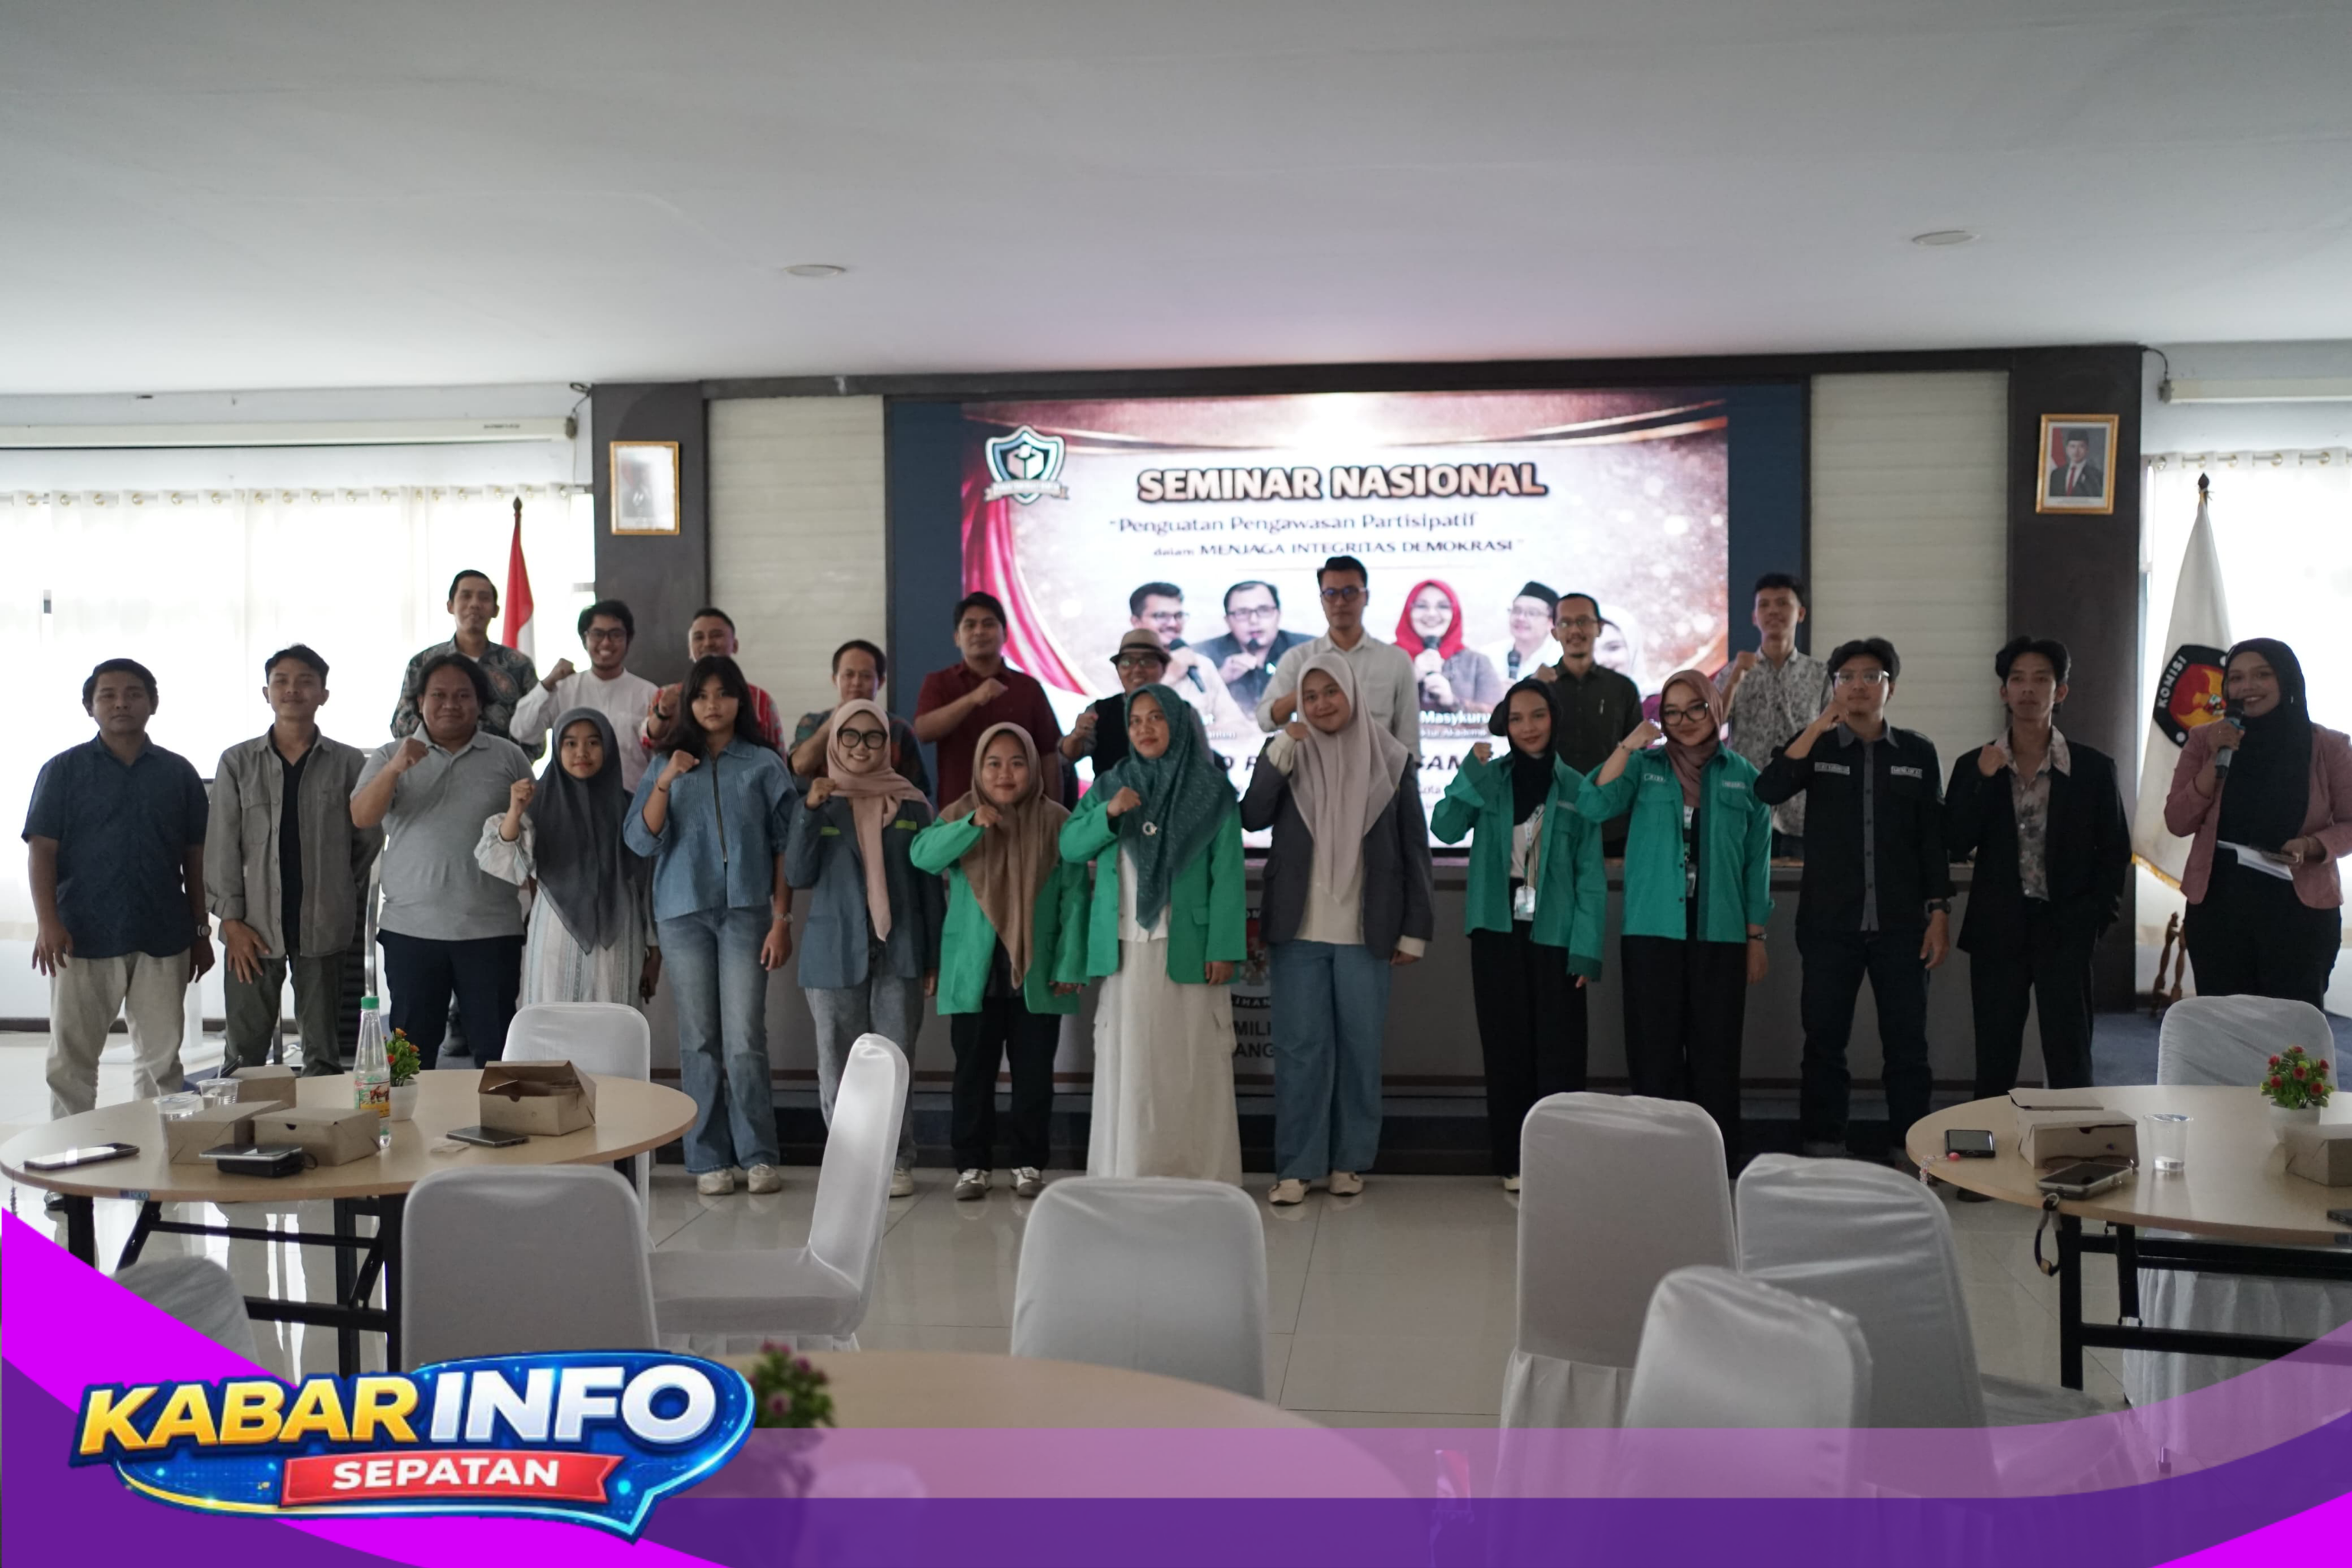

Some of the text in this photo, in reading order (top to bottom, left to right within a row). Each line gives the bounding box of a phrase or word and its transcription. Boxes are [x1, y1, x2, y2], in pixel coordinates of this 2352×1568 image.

[1138, 462, 1548, 502] SEMINAR NASIONAL
[1230, 514, 1356, 534] Pengawasan
[1362, 512, 1477, 531] Partisipatif
[1200, 543, 1285, 556] MENJAGA
[1292, 541, 1396, 554] INTEGRITAS
[2158, 655, 2187, 708] KOMISI
